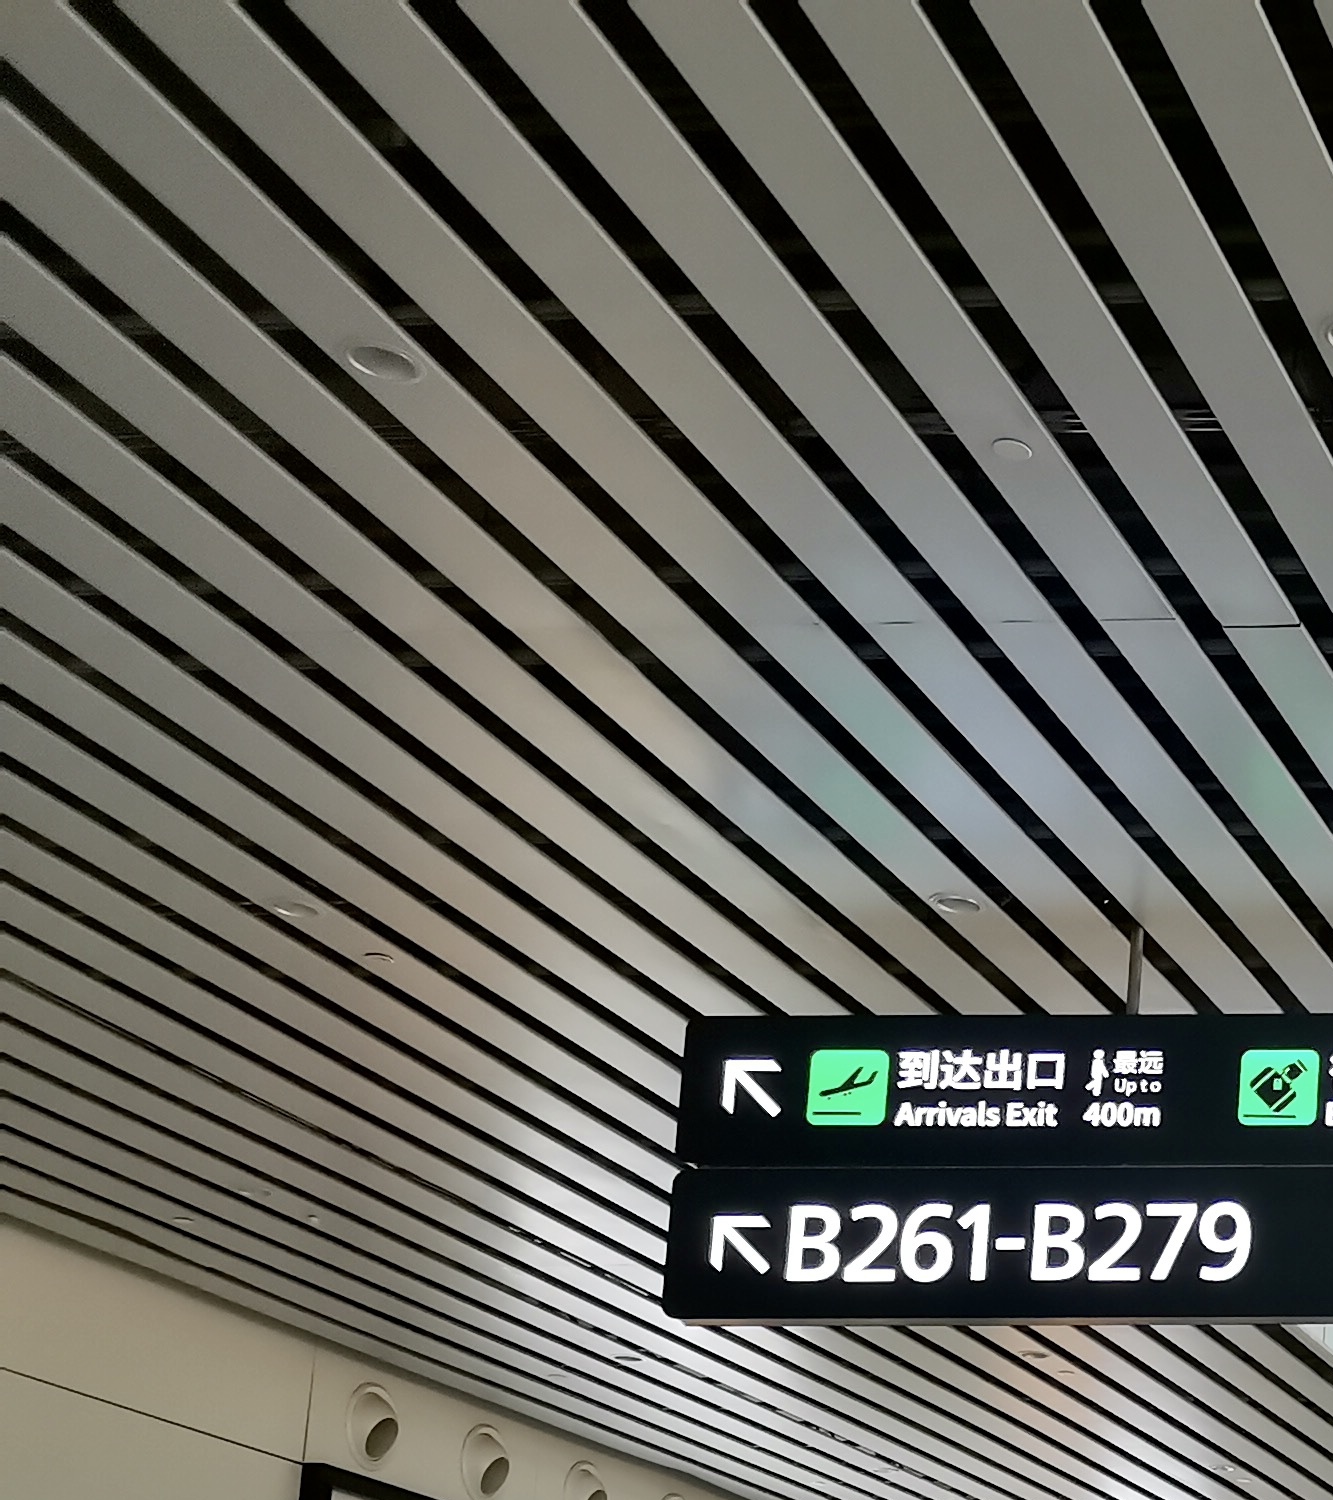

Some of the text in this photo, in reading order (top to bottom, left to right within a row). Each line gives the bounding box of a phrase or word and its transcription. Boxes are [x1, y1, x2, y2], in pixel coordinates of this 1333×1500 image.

[897, 1049, 1065, 1090] 到达出口
[1113, 1050, 1164, 1074] 最远
[1114, 1078, 1161, 1097] Up to
[894, 1101, 1058, 1128] Arrivals Exit
[1082, 1101, 1161, 1127] 400m
[784, 1201, 1252, 1283] B261-B279
